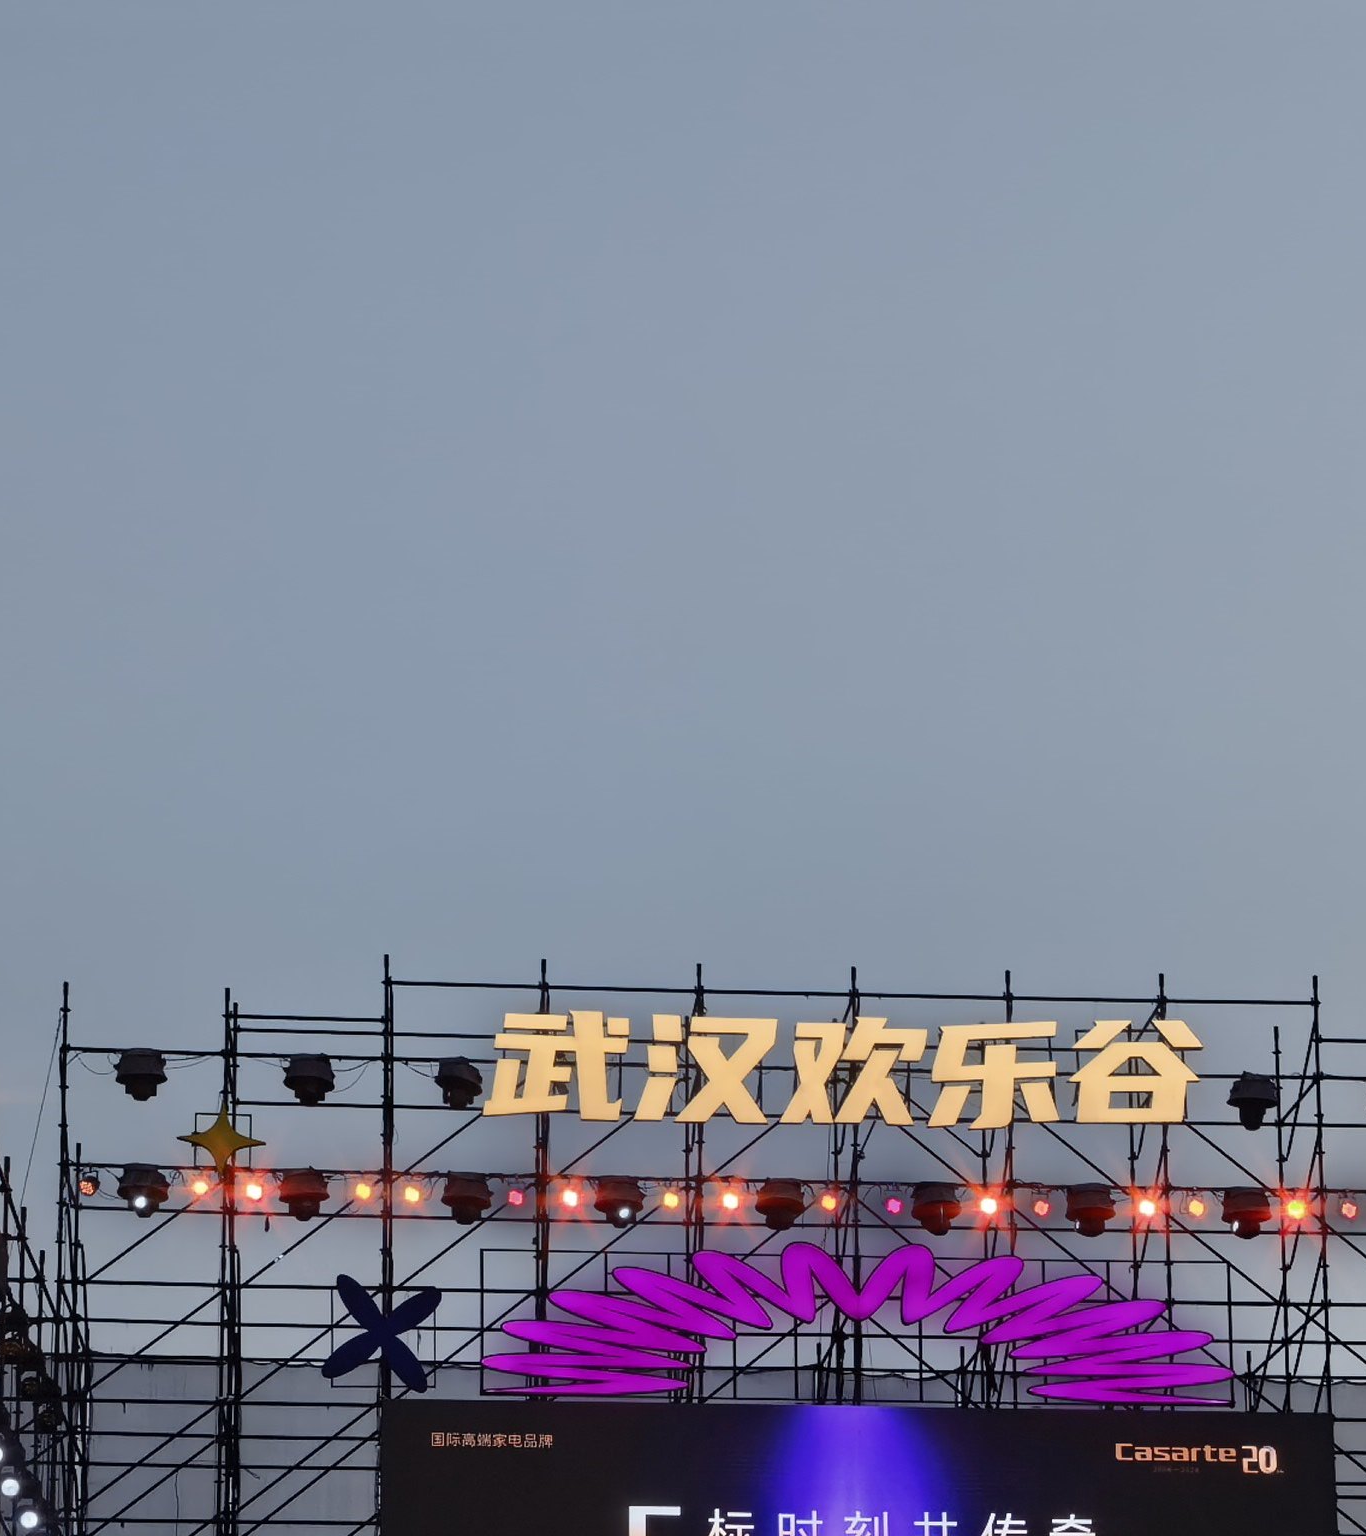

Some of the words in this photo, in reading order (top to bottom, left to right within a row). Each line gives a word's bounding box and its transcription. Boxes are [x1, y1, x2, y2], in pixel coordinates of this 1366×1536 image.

[482, 1011, 1203, 1129] 武汉欢乐谷
[431, 1432, 553, 1448] 国际高端家电品牌
[1114, 1443, 1237, 1462] Casarte
[1241, 1445, 1278, 1474] 20
